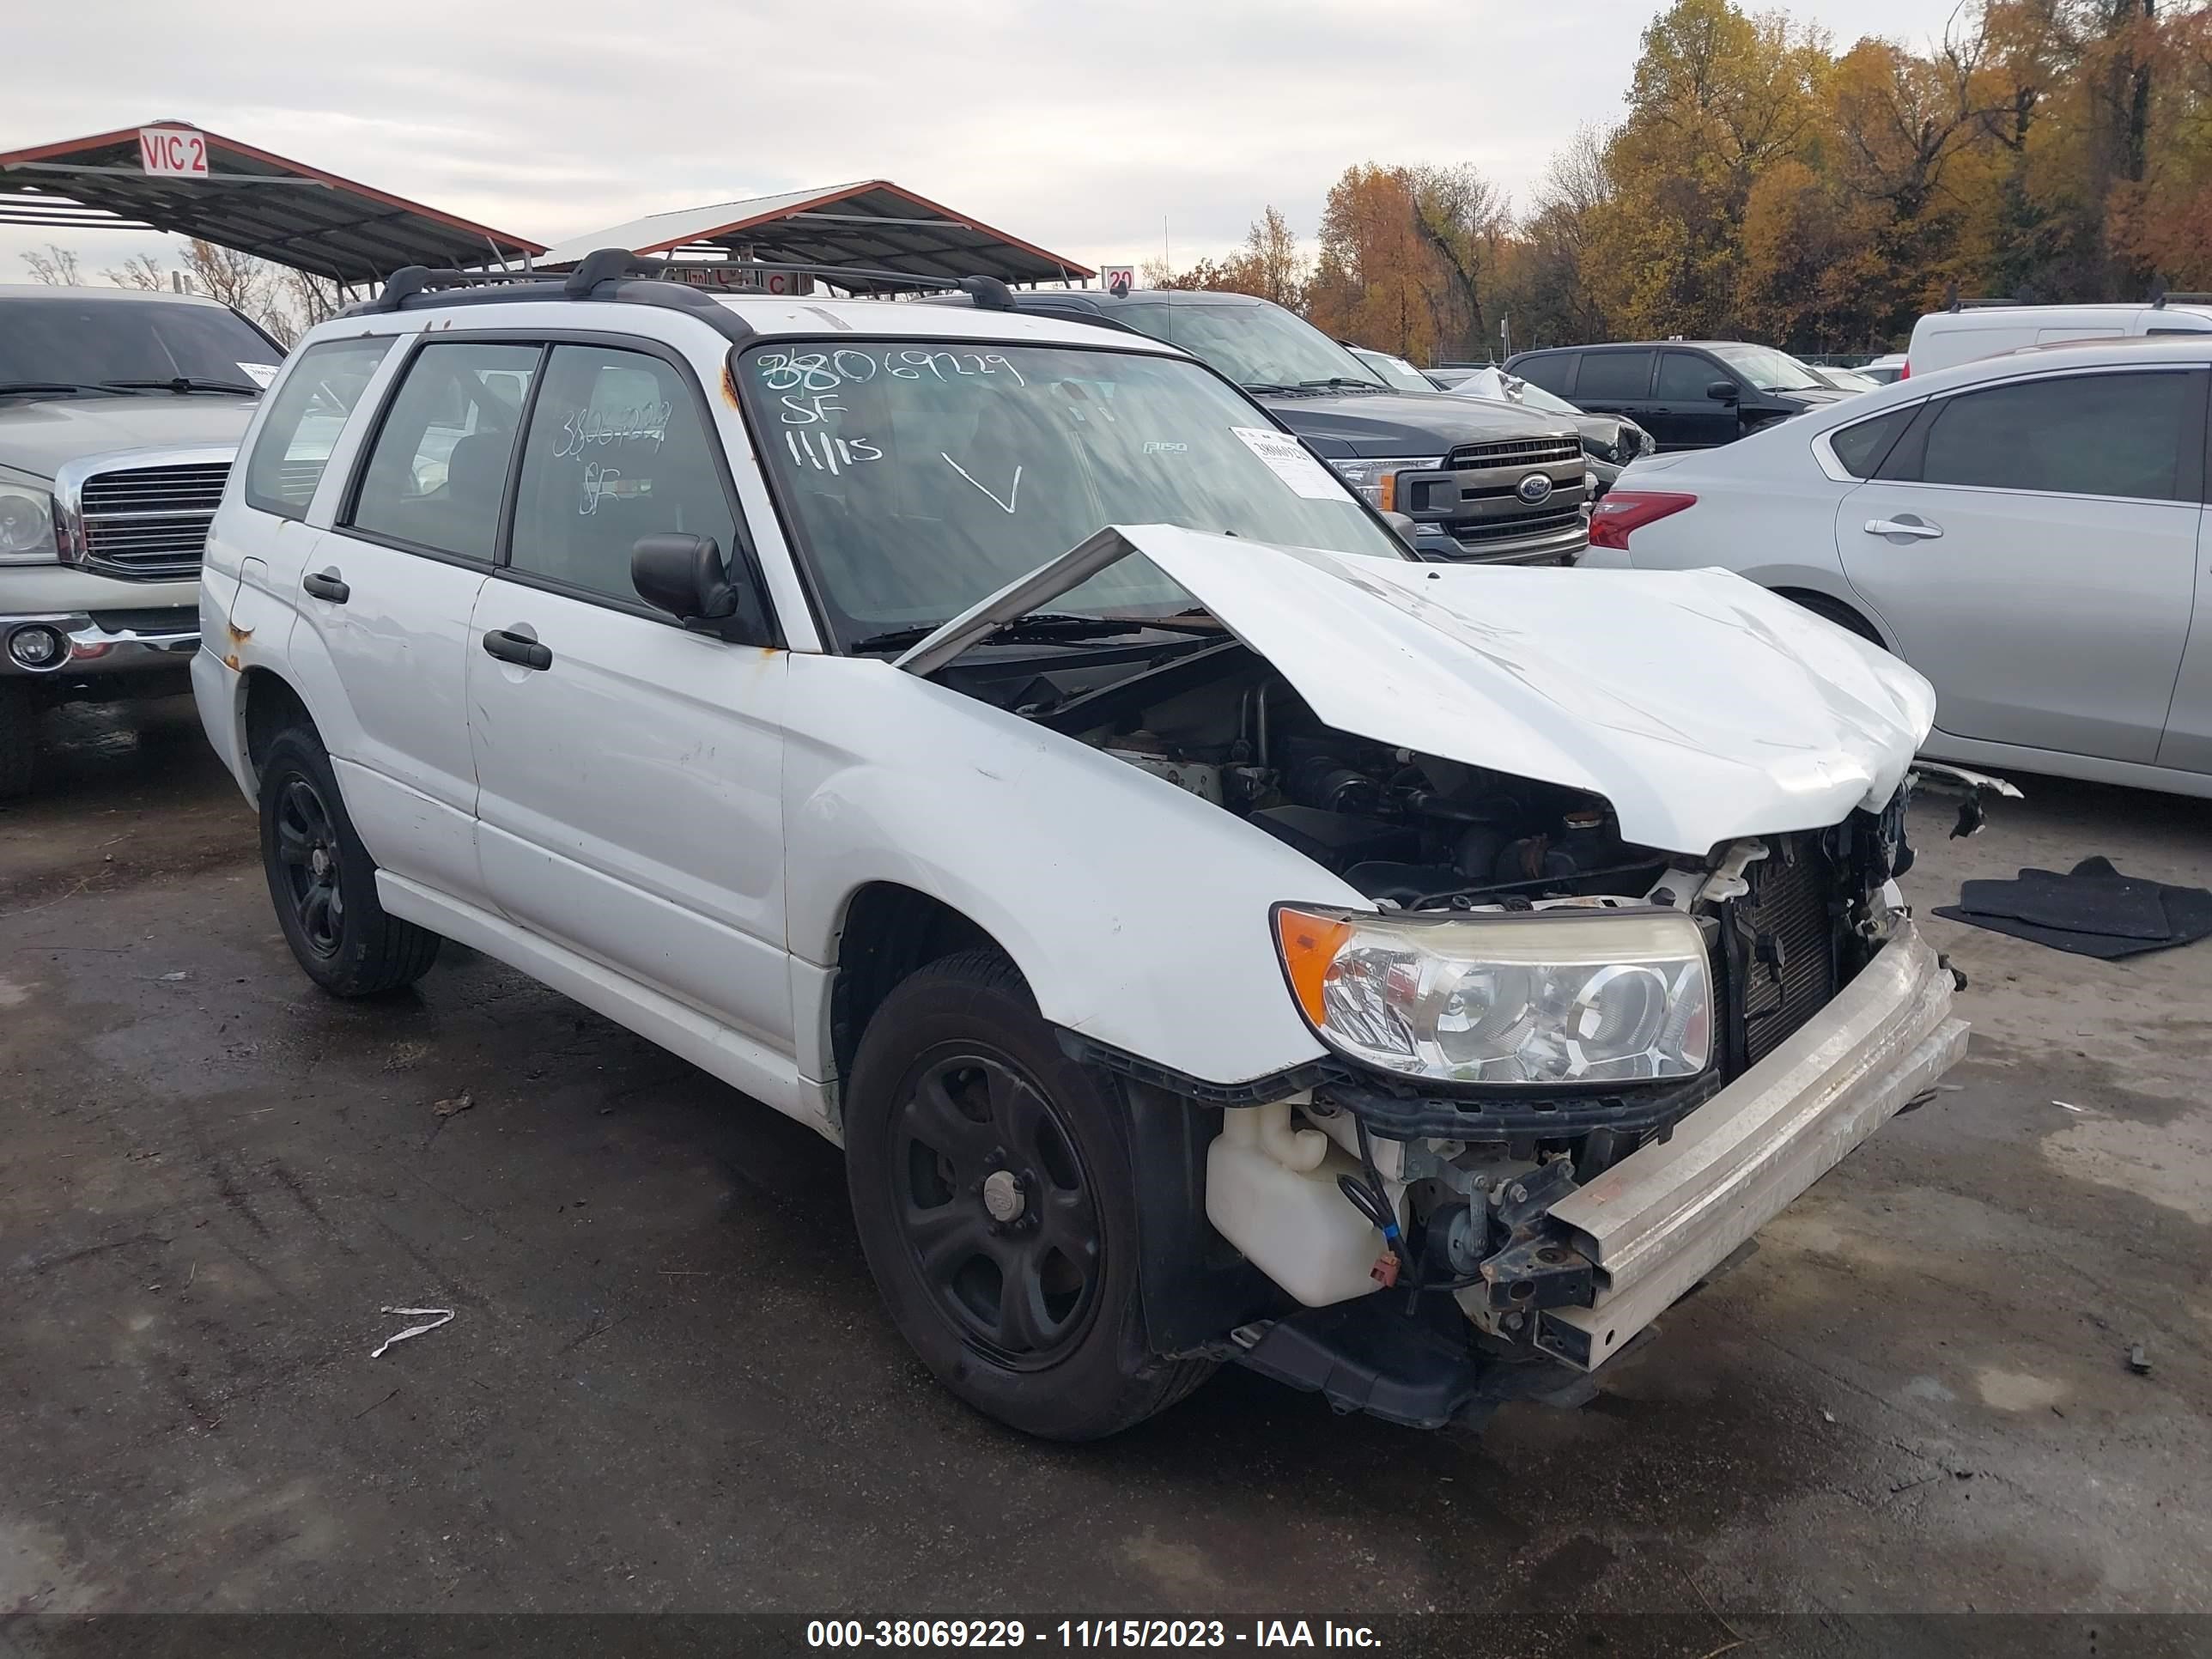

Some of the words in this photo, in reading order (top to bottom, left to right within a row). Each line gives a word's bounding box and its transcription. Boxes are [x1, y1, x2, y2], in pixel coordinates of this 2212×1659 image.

[143, 135, 185, 170] VIC
[190, 138, 206, 171] 2
[1109, 270, 1133, 289] 20
[780, 393, 849, 425] SF
[785, 429, 884, 476] 11/15
[578, 461, 621, 516] SF
